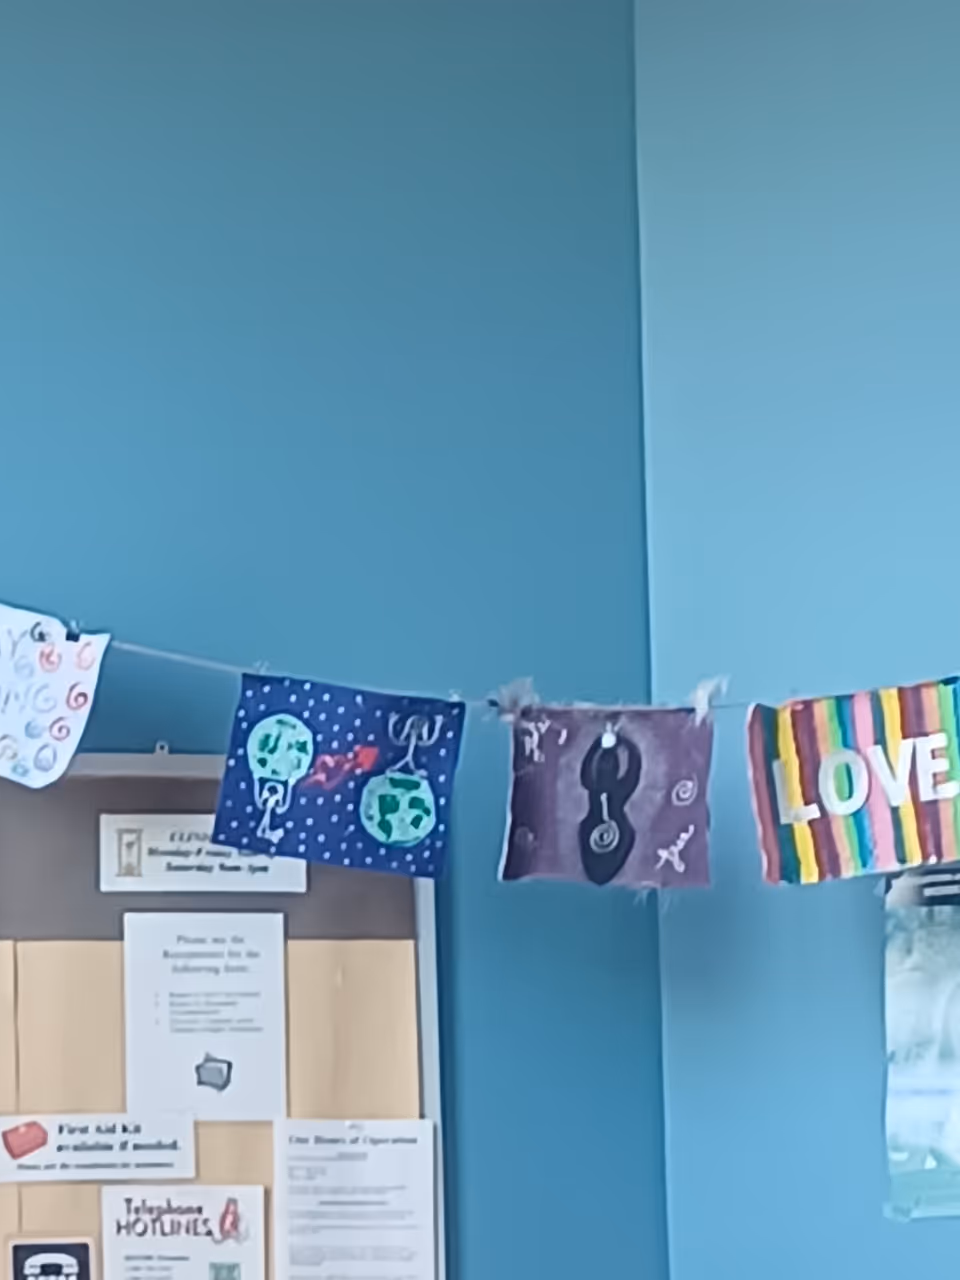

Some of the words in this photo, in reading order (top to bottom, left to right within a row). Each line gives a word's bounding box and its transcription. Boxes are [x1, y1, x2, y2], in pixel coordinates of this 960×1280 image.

[771, 731, 960, 825] LOVE
[57, 1124, 89, 1135] First
[95, 1124, 116, 1135] Aid
[120, 1124, 141, 1135] Kit
[123, 1197, 204, 1221] Telephone
[115, 1217, 213, 1237] HOTLINES
